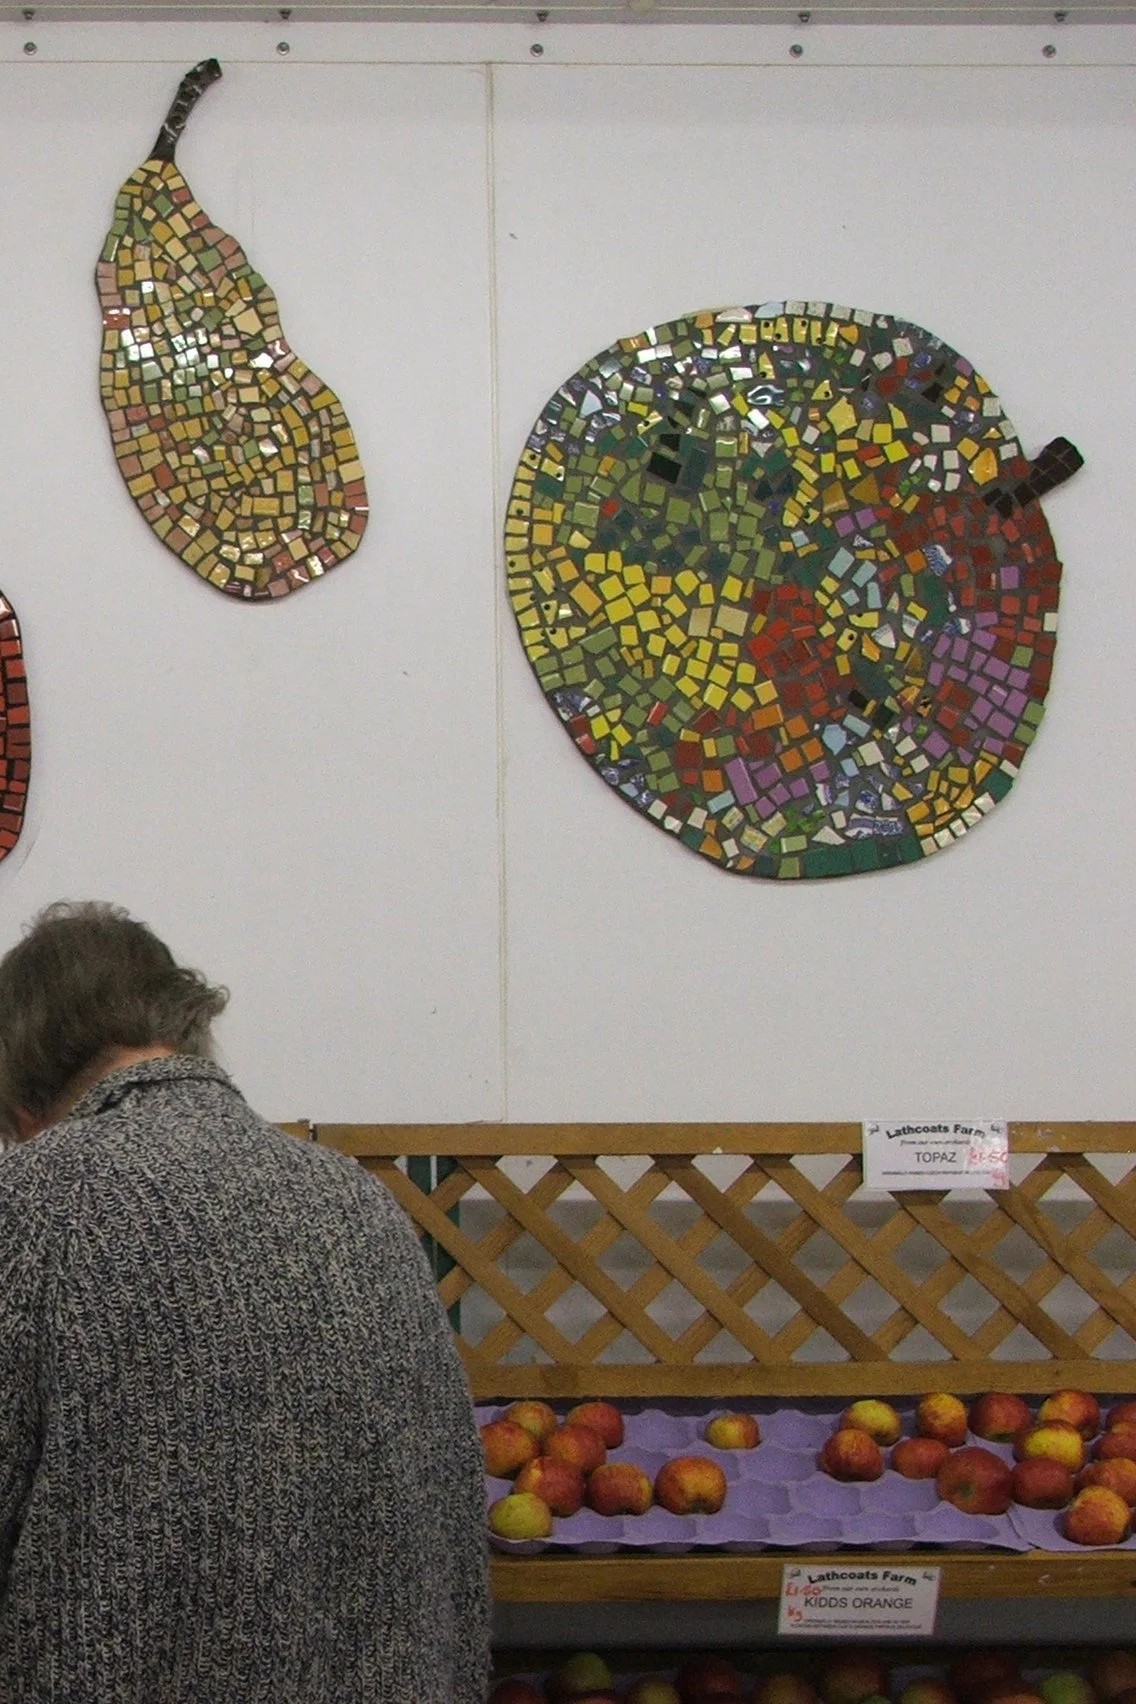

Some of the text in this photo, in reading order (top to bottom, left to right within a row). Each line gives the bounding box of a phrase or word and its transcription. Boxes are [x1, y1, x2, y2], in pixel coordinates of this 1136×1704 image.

[885, 1123, 985, 1139] Lathcoats Farm
[915, 1151, 957, 1163] TOPAZ
[807, 1570, 917, 1585] Lathcoats Farm
[804, 1597, 913, 1609] KIDDS ORANGE
